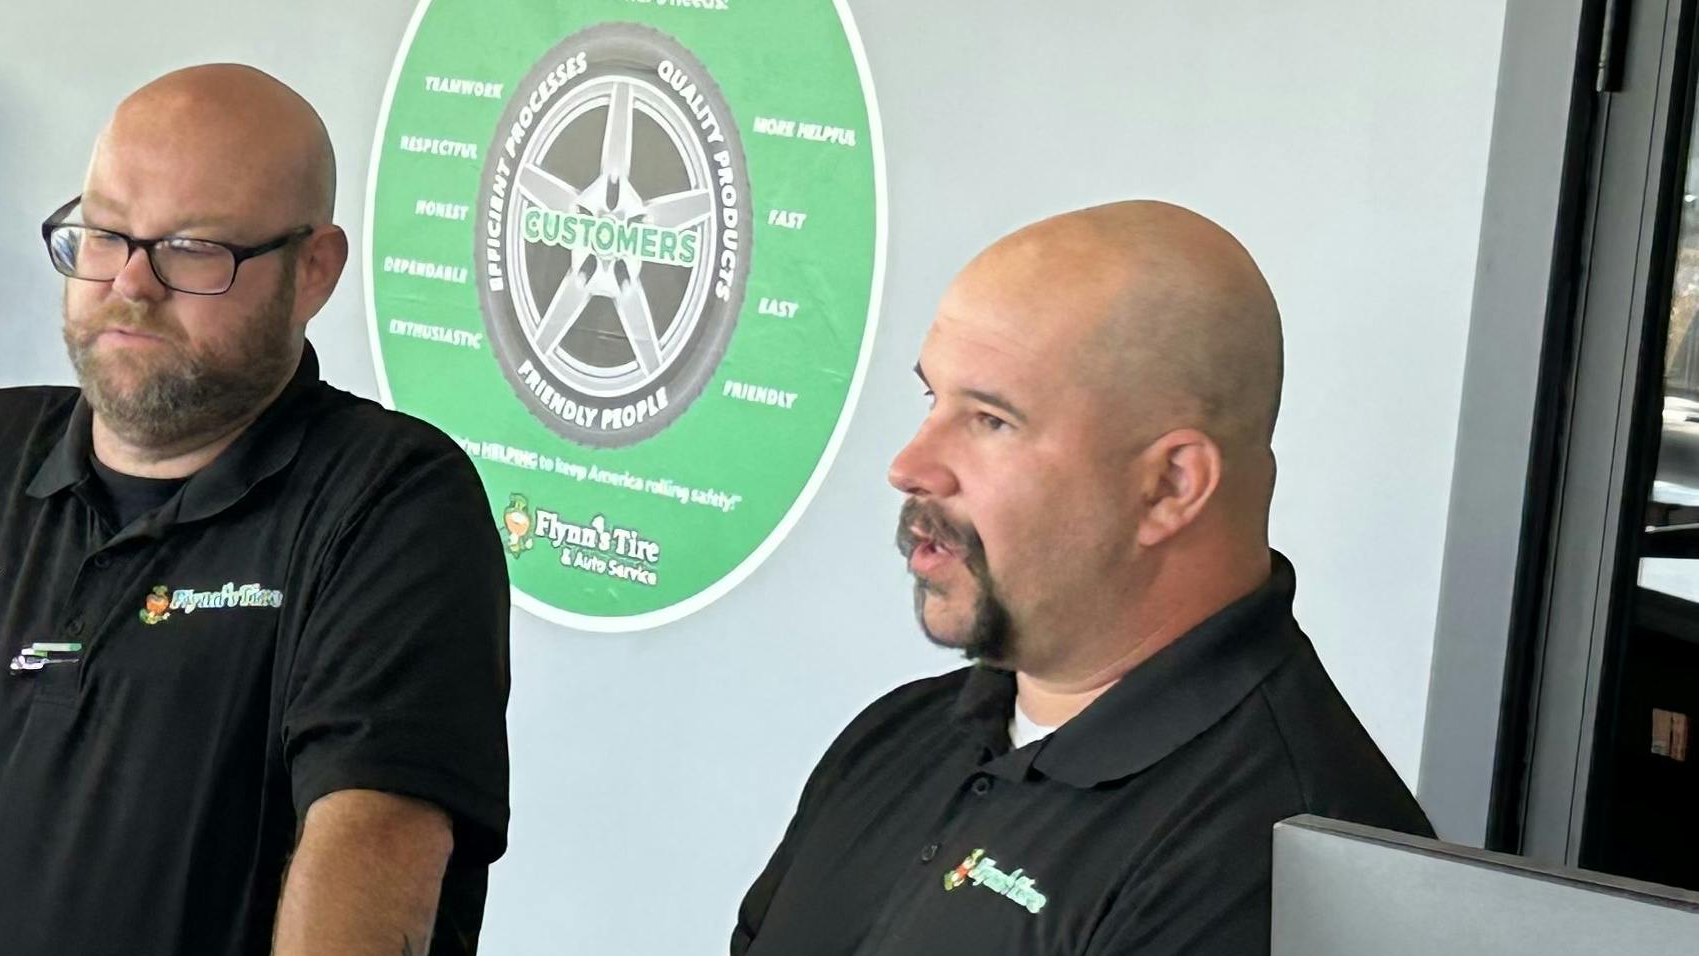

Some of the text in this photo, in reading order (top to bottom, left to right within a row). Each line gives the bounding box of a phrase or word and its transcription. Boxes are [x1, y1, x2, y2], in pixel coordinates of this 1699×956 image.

[425, 76, 504, 98] TEAMWORK
[752, 116, 856, 147] MORE HELPFUL
[400, 135, 478, 159] RESPECTFUL
[487, 51, 588, 292] EFFICIENT PROCESSES
[657, 59, 739, 302] QUALITY PRODUCTS
[415, 200, 469, 221] HONEST
[767, 209, 807, 230] FAST
[524, 209, 698, 264] CUSTOMERS
[384, 256, 468, 284] DEPENDABLE
[758, 298, 800, 318] EASY
[389, 319, 483, 349] ENTHUSIASTIC
[517, 359, 668, 430] FRIENDLY PEOPLE
[722, 380, 798, 409] FRIENDLY
[482, 441, 538, 470] HELPING
[539, 454, 555, 472] to
[555, 457, 587, 482] keep
[588, 464, 644, 493] America
[645, 478, 689, 505] rolling
[534, 508, 661, 562] Flynn's Tire
[560, 549, 657, 585] & Auto Service
